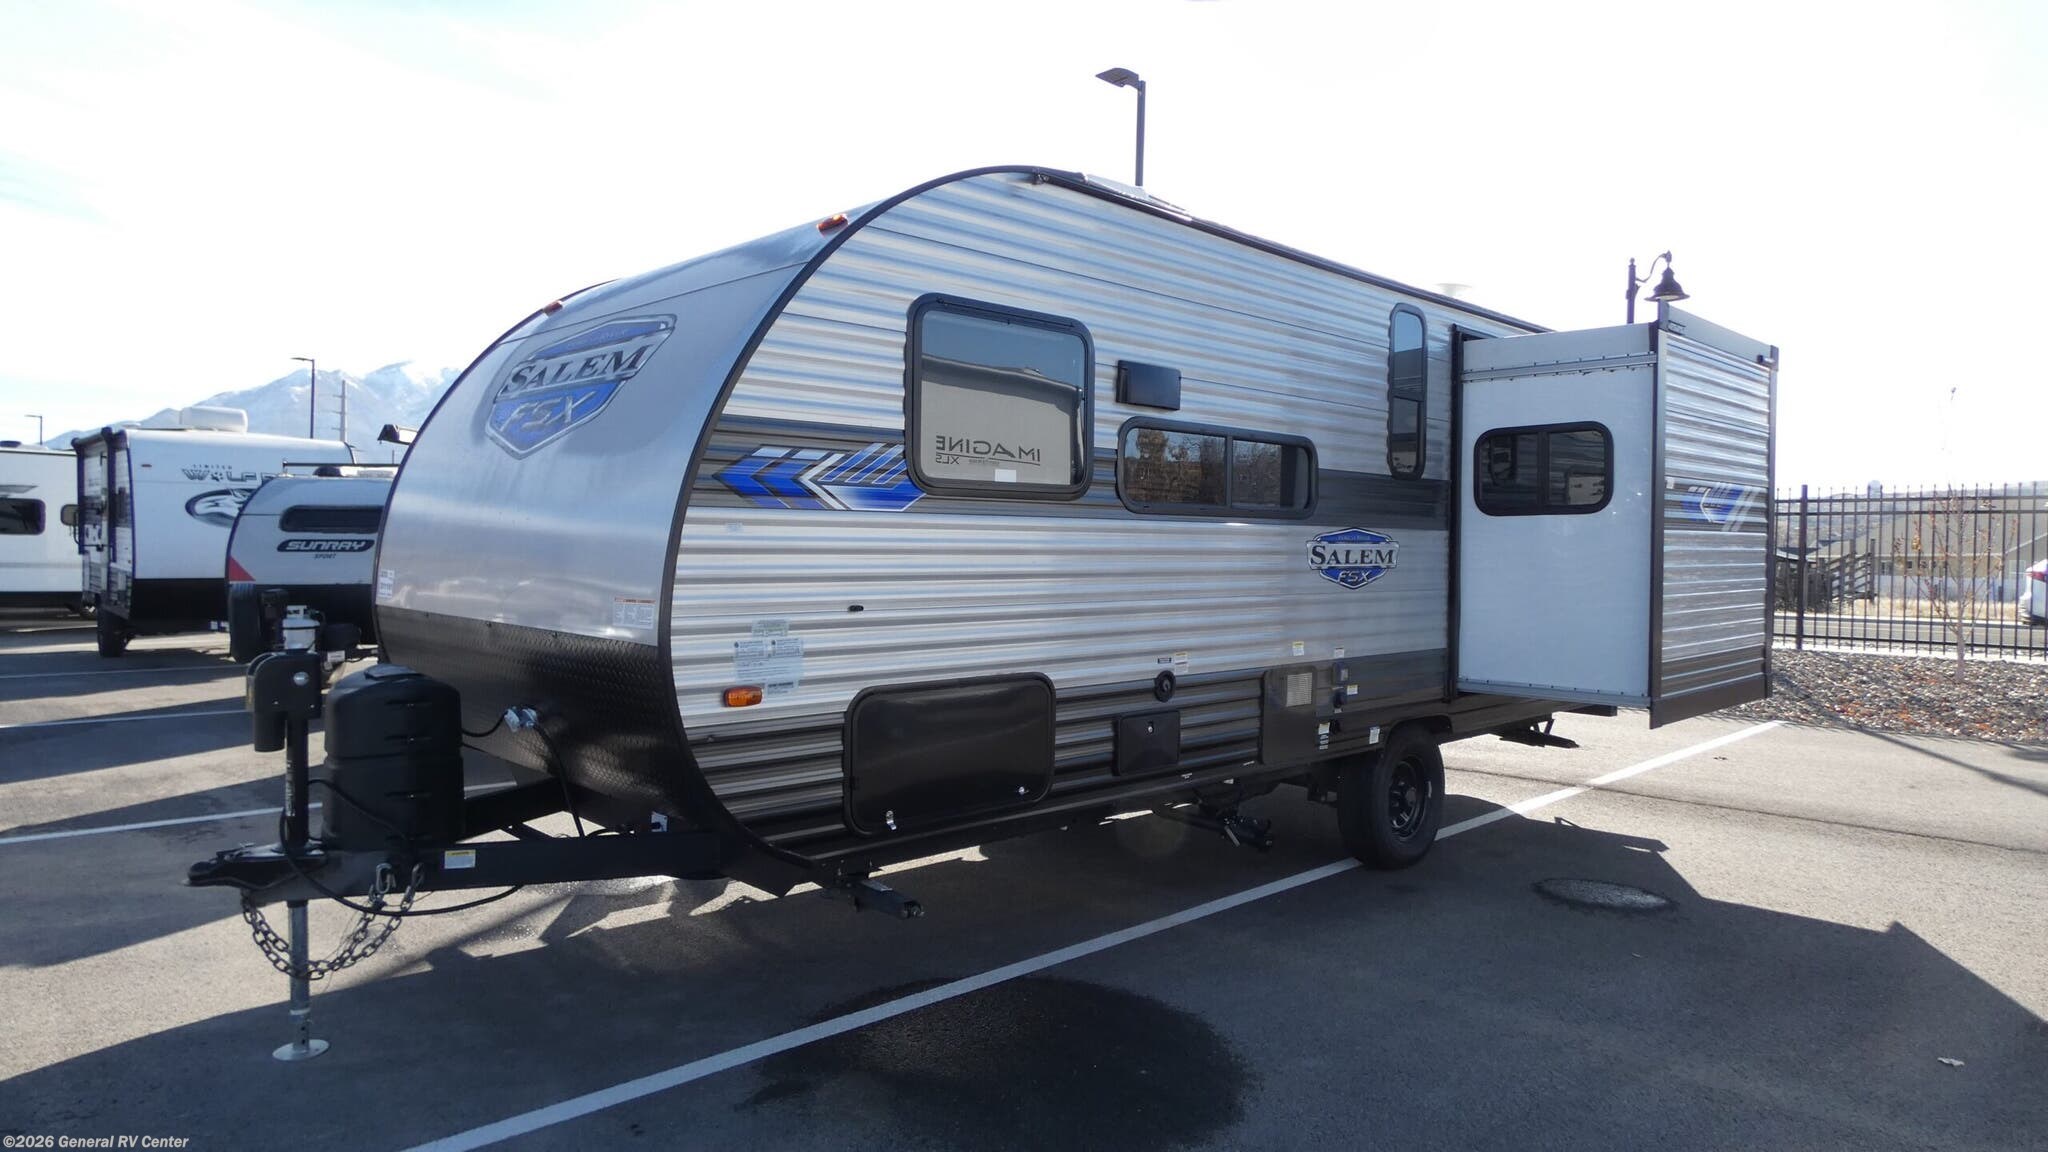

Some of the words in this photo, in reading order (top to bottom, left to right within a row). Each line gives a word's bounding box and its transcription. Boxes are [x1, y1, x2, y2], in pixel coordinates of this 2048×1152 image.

[500, 345, 653, 395] SALEM
[500, 390, 598, 432] FSX
[286, 541, 367, 551] SUNRAY
[1310, 545, 1396, 566] SALEM
[1337, 570, 1373, 585] FSX
